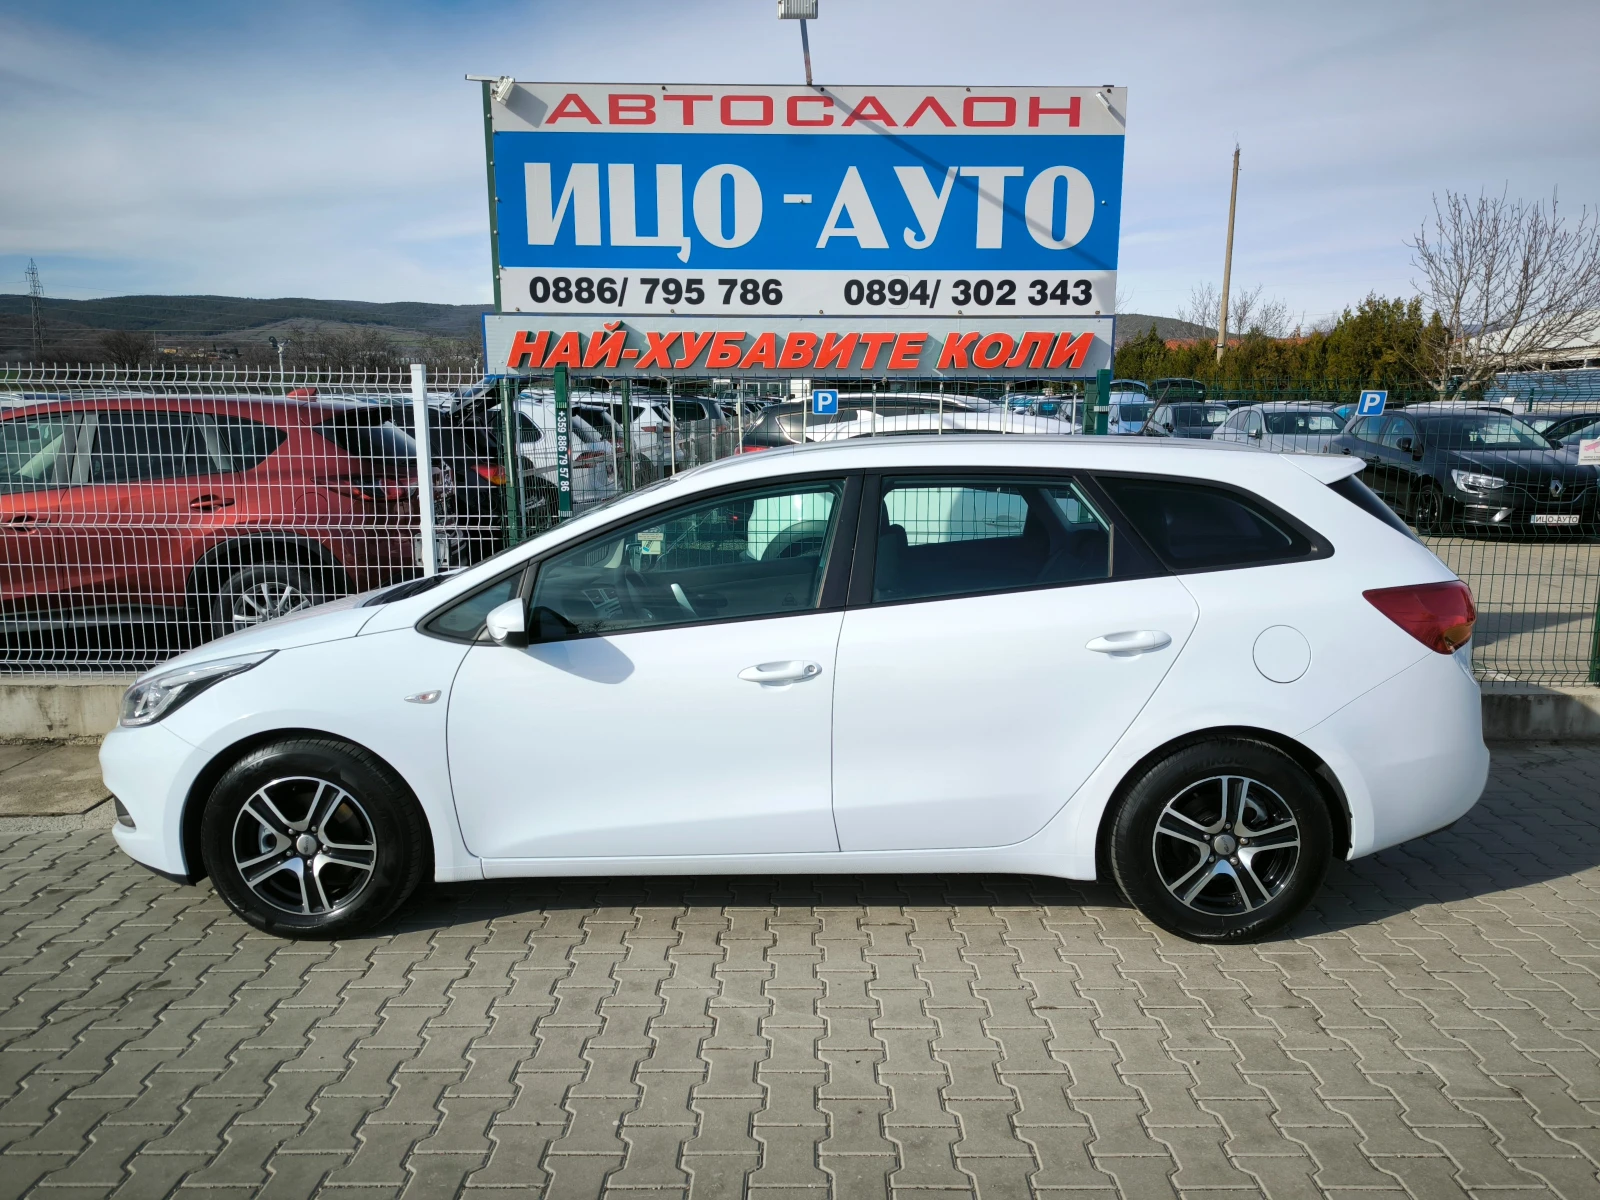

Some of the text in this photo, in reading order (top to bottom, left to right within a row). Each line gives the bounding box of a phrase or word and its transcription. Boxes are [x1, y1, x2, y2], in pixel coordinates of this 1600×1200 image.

[546, 93, 1081, 128] АВТОСАЛОН
[529, 276, 783, 306] 0886/ 795 786
[844, 278, 1093, 308] 0894/ 302 343
[508, 320, 1095, 370] НАЙ-ХУБАВИТЕ КОЛИ
[818, 392, 833, 412] P
[1363, 393, 1381, 413] P
[557, 410, 570, 492] +359 886 79 57 86
